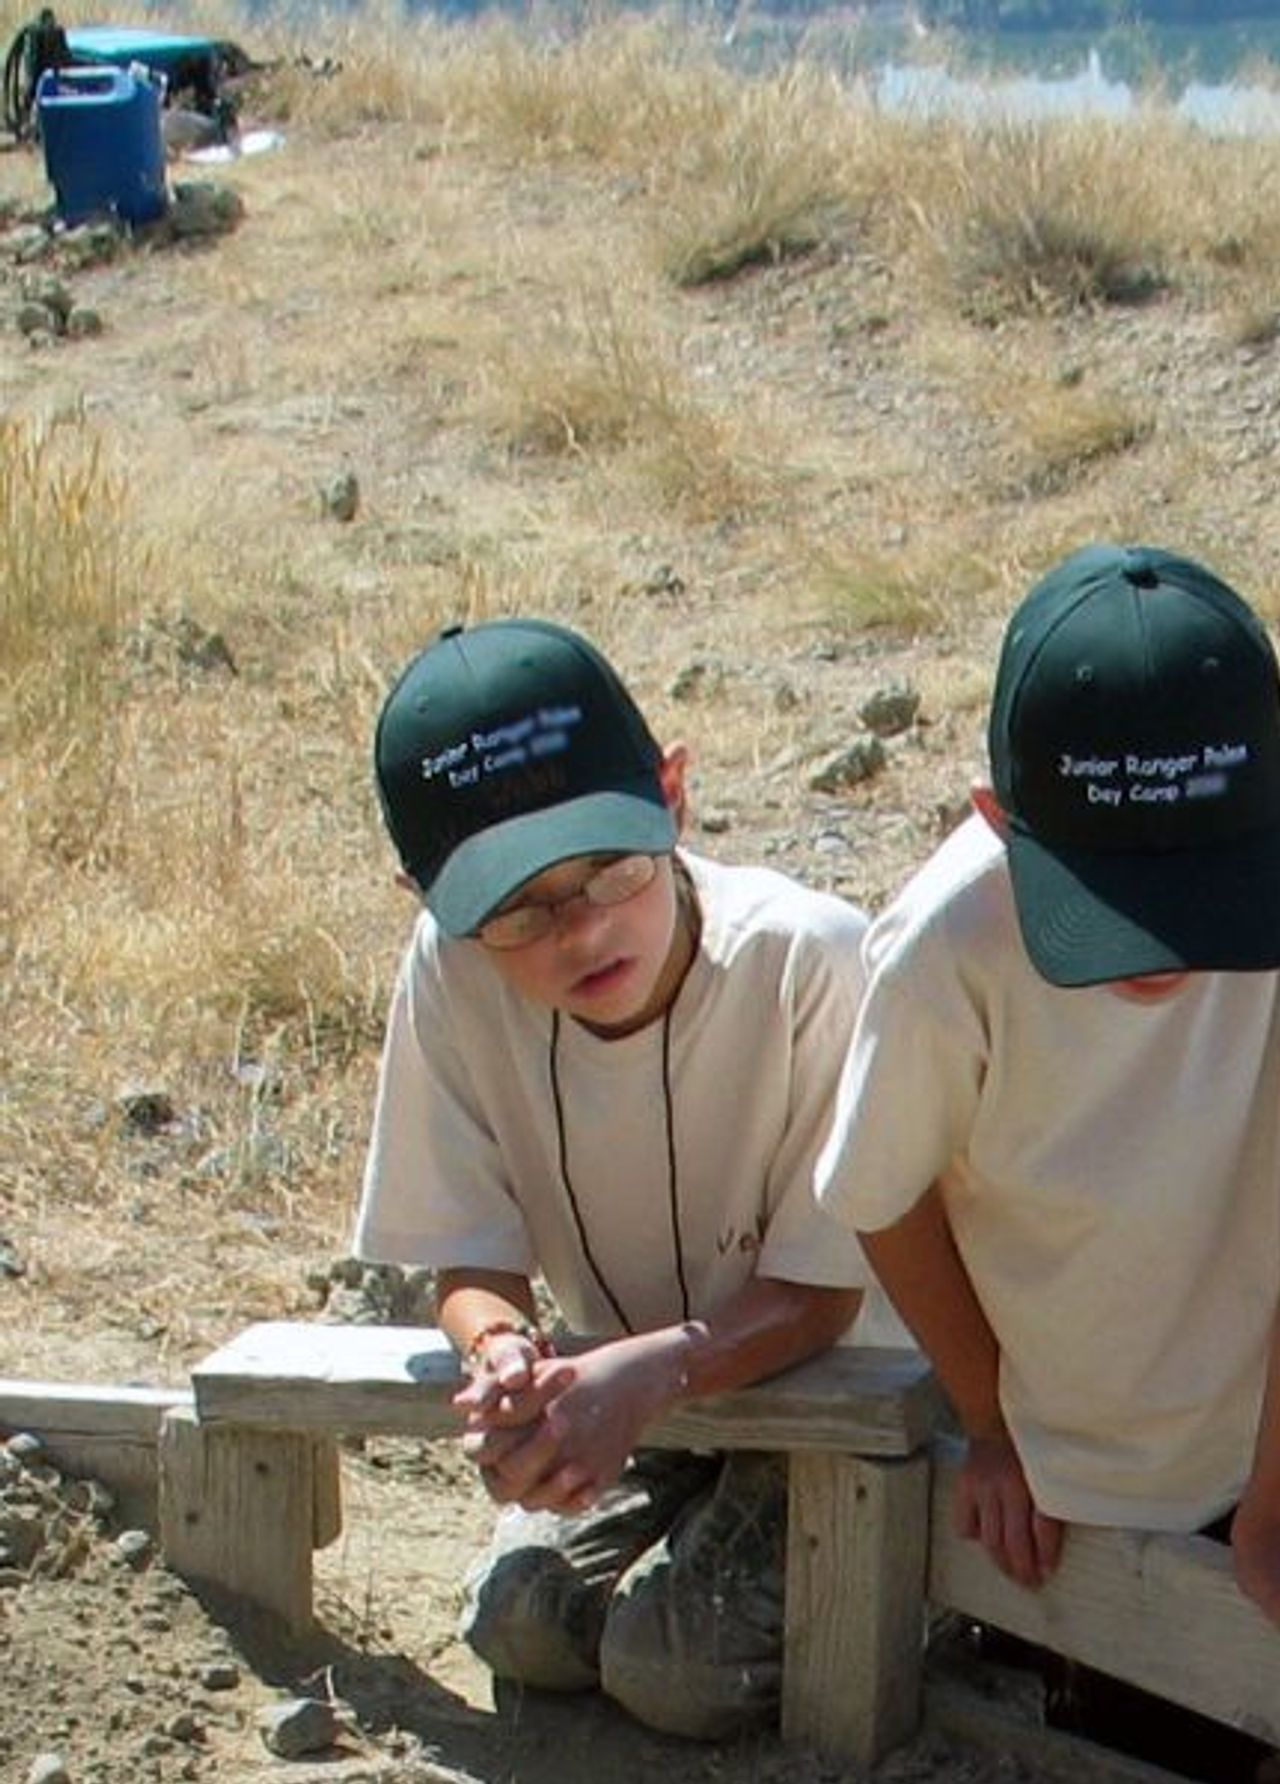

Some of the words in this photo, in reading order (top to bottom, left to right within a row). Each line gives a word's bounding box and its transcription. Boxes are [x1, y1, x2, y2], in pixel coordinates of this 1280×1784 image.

[1060, 754, 1117, 776] Junior
[1125, 754, 1198, 779] Ranger
[1088, 783, 1122, 806] Day
[1130, 784, 1179, 802] Camp
